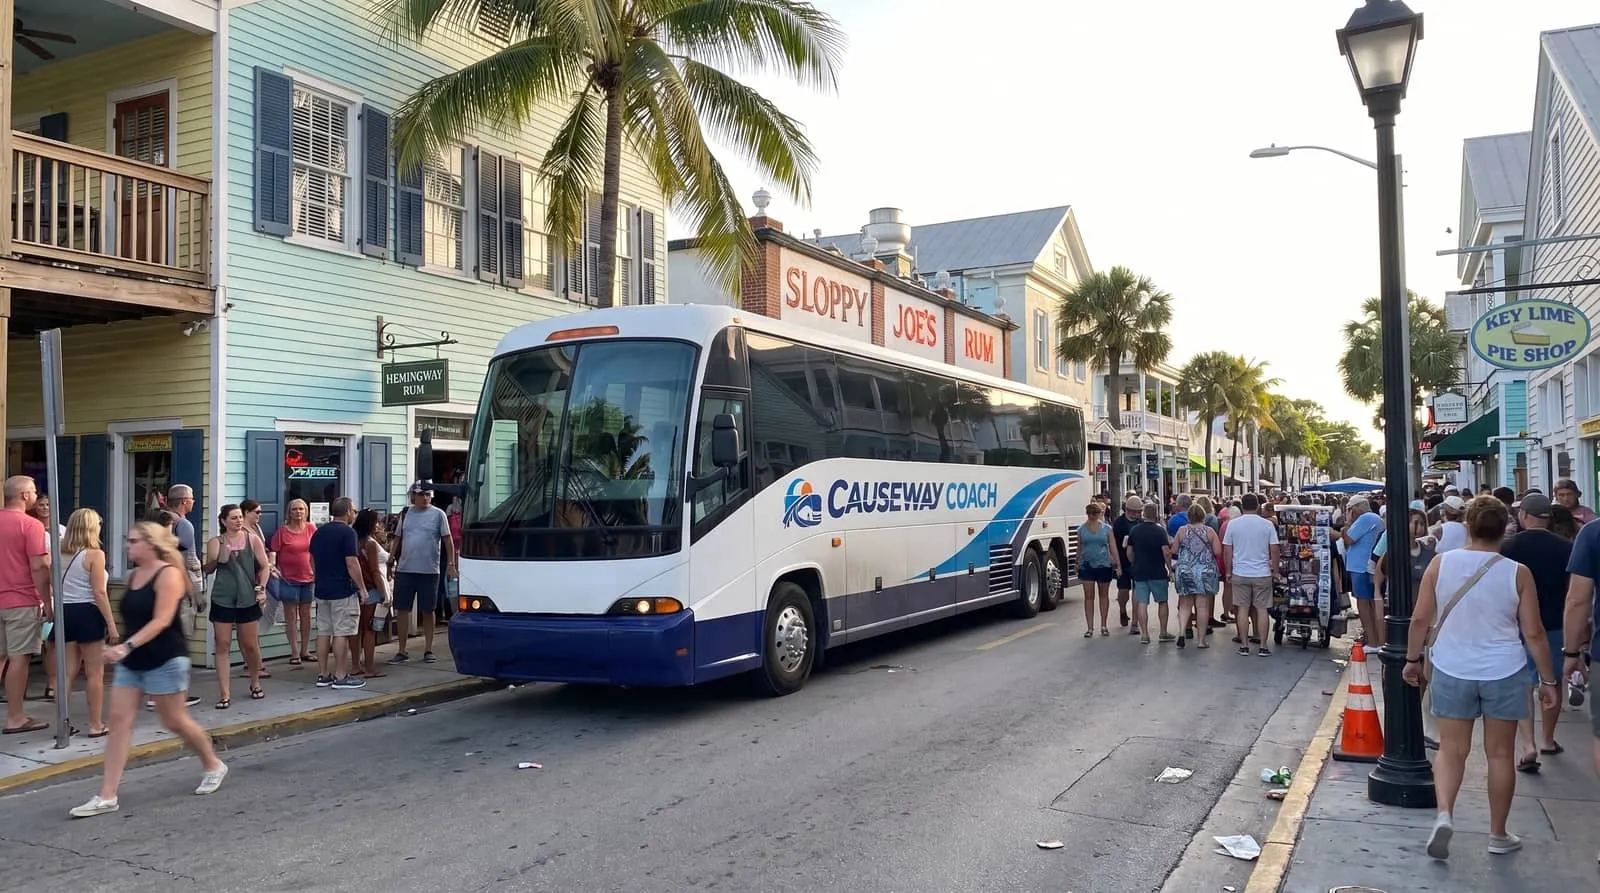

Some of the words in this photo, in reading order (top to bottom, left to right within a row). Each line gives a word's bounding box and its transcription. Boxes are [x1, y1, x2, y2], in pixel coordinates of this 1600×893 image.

[786, 265, 868, 327] SLOPPY
[893, 303, 937, 347] JOE'S
[964, 327, 994, 365] RUM
[1486, 307, 1523, 331] KEY
[1528, 306, 1576, 325] LIME
[1487, 344, 1517, 362] PIE
[1523, 339, 1576, 362] SHOP
[386, 369, 443, 384] HEMINGWAY
[403, 384, 425, 396] RUM
[828, 478, 944, 518] CAUSEWAY
[946, 482, 998, 510] COACH
